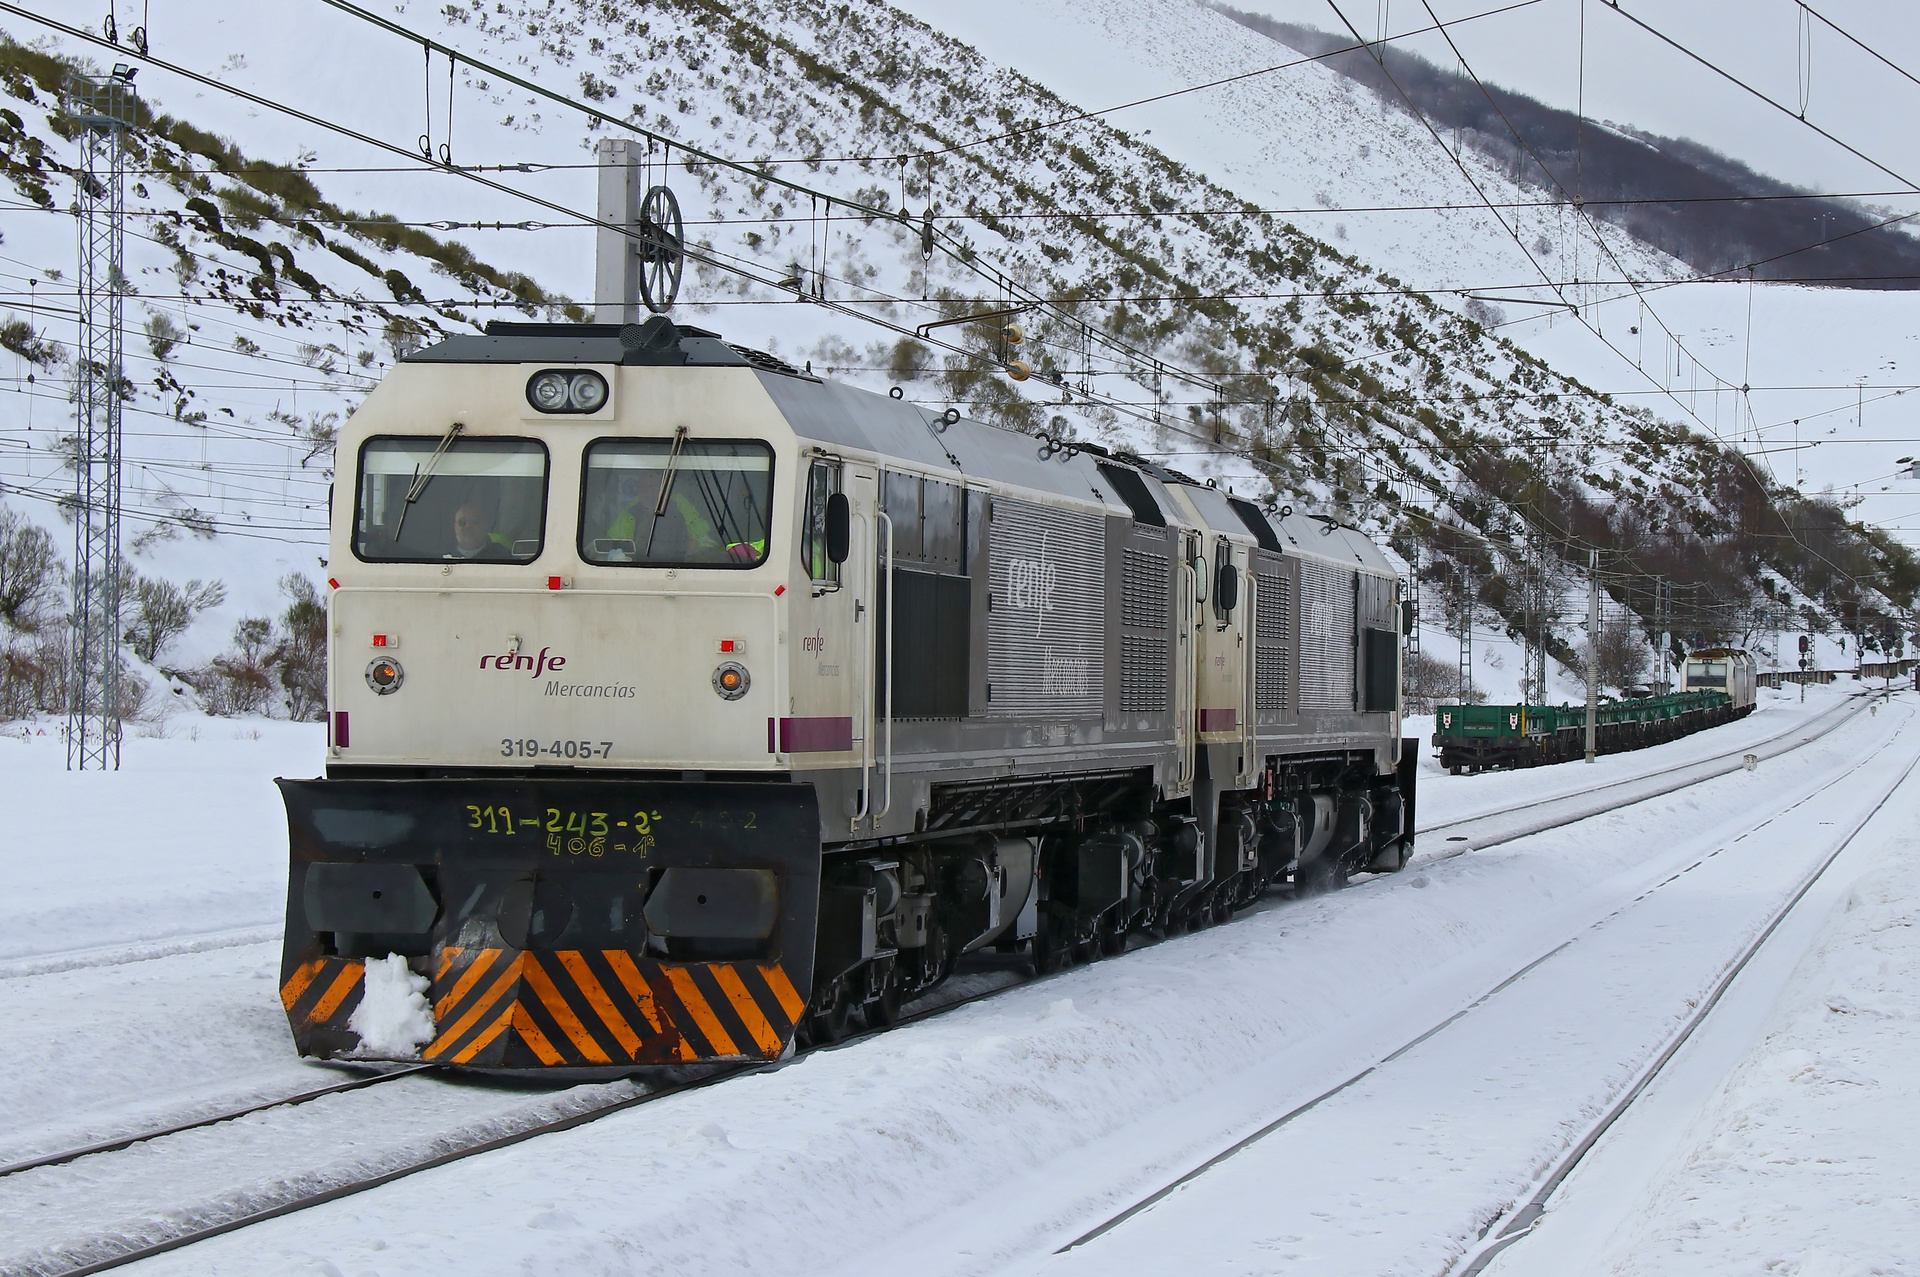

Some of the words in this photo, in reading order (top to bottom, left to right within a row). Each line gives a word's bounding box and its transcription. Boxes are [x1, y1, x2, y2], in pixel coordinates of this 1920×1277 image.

[1007, 529, 1056, 638] renfe
[802, 627, 824, 660] renfe
[480, 646, 567, 680] renfe
[544, 680, 636, 698] Mercancías
[501, 738, 614, 759] 319-405-7
